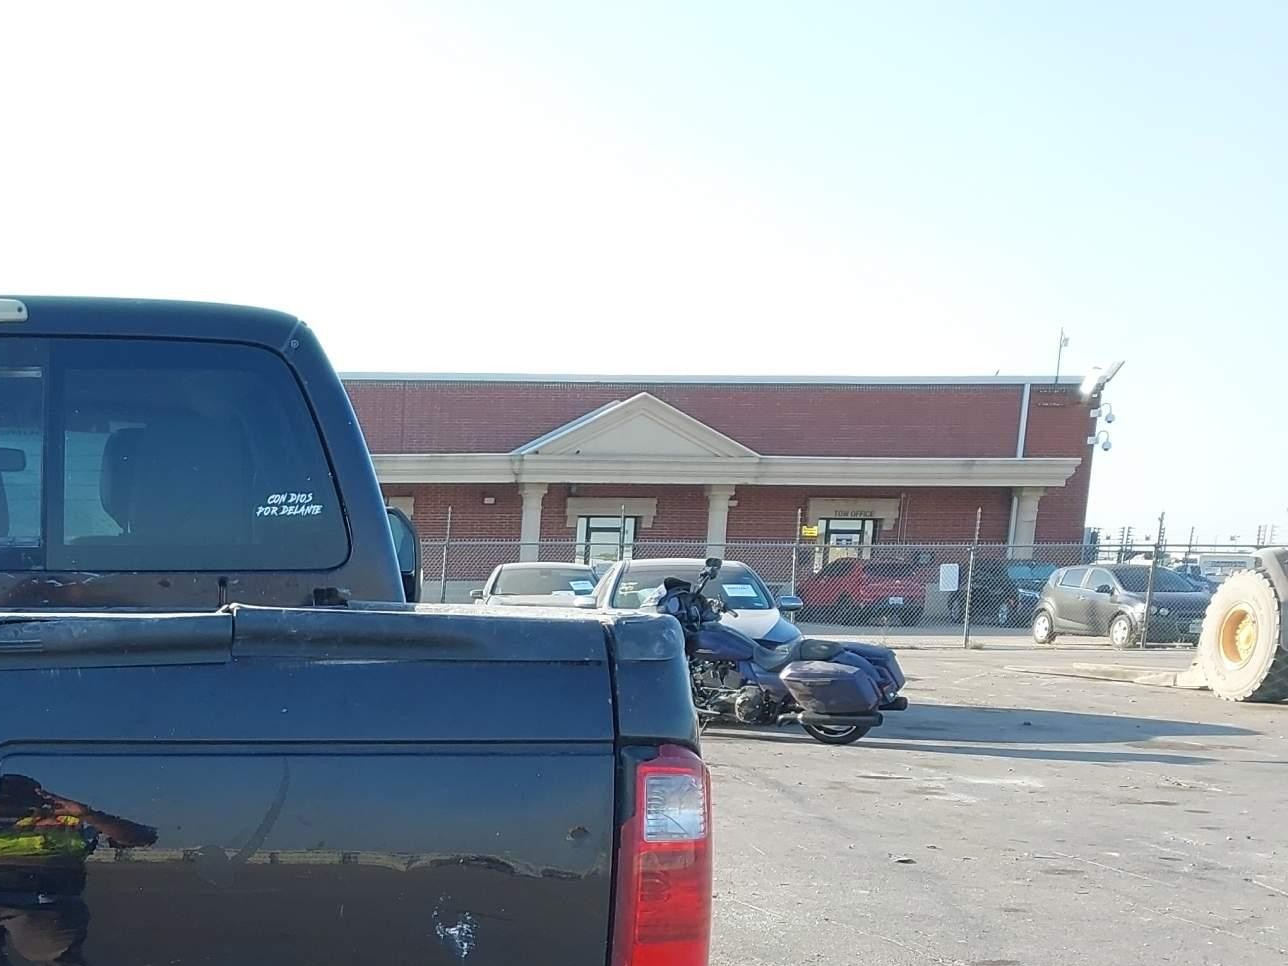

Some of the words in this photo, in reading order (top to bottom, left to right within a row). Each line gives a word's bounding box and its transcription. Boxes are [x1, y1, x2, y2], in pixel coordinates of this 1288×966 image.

[267, 492, 288, 505] CON
[287, 492, 313, 504] DIOS
[255, 505, 279, 517] POR
[278, 504, 323, 516] DELANTE
